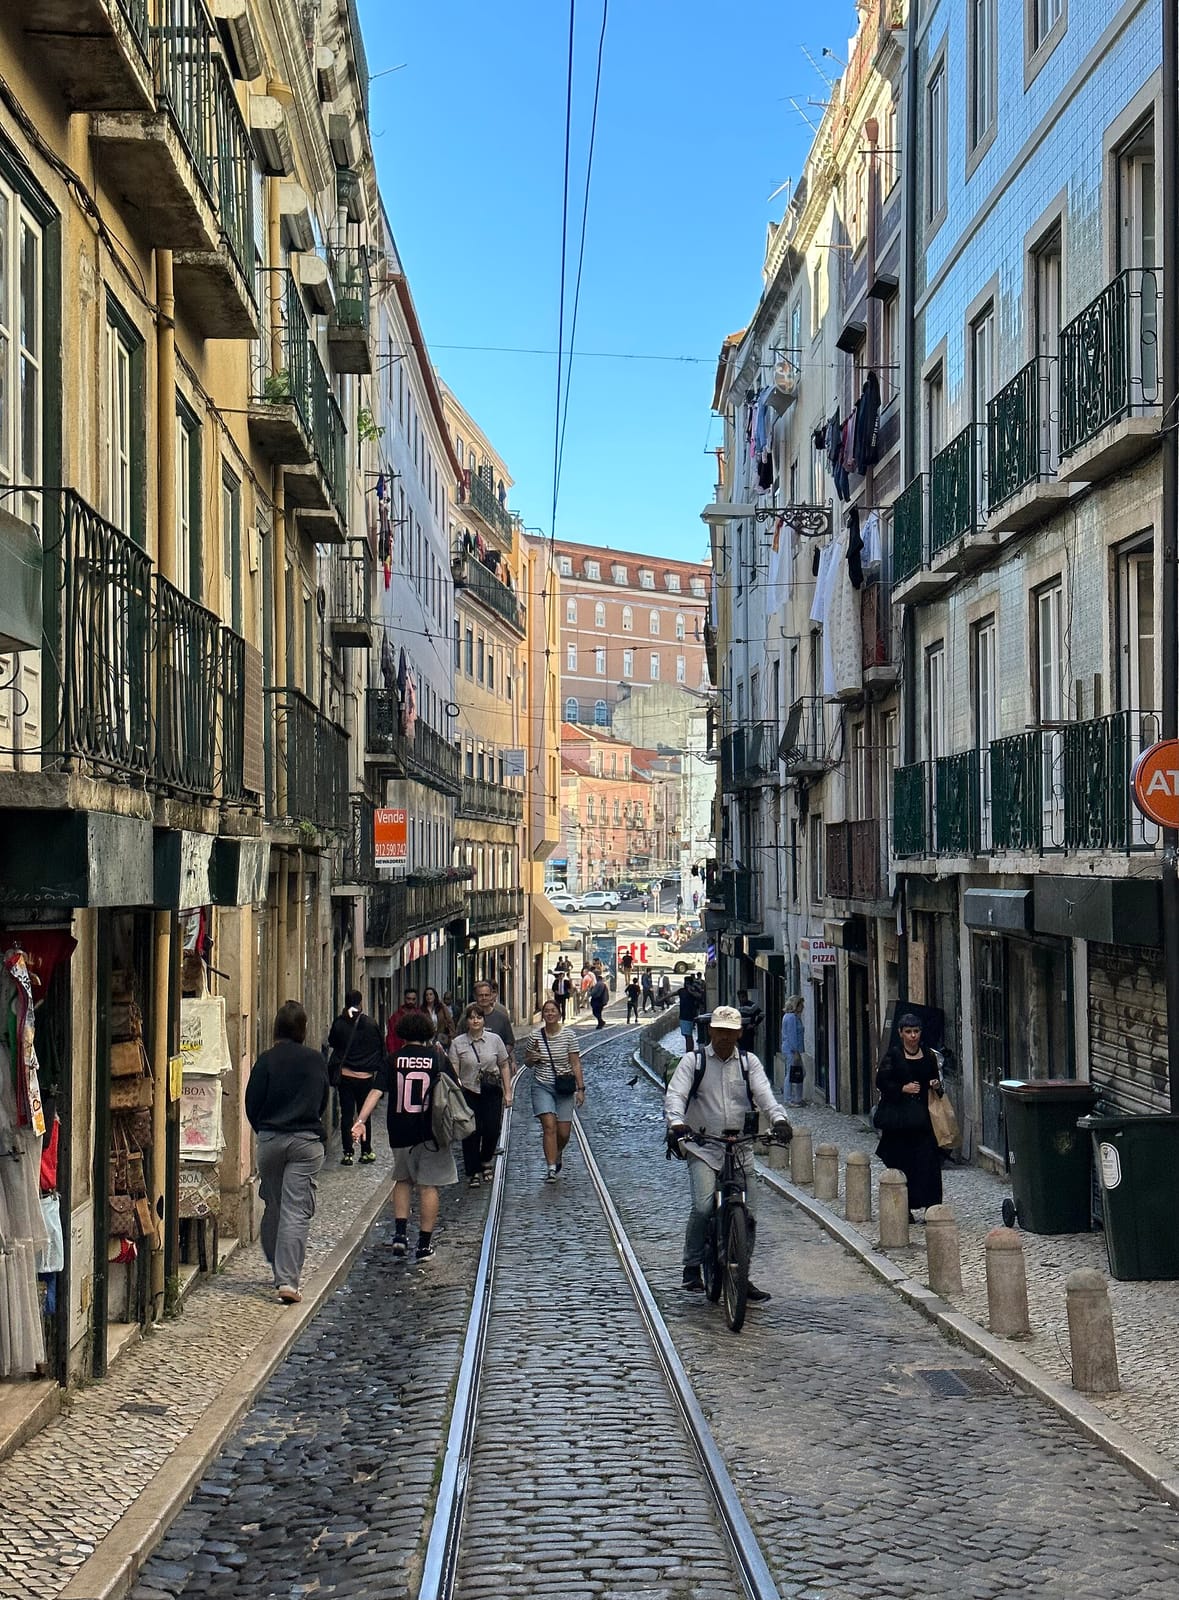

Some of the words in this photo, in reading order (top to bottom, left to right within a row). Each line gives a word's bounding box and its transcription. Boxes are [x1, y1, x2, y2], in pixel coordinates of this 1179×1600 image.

[377, 810, 404, 824] Vende
[812, 954, 836, 963] PIZZA
[397, 1056, 433, 1069] MESSI
[396, 1071, 431, 1113] 10
